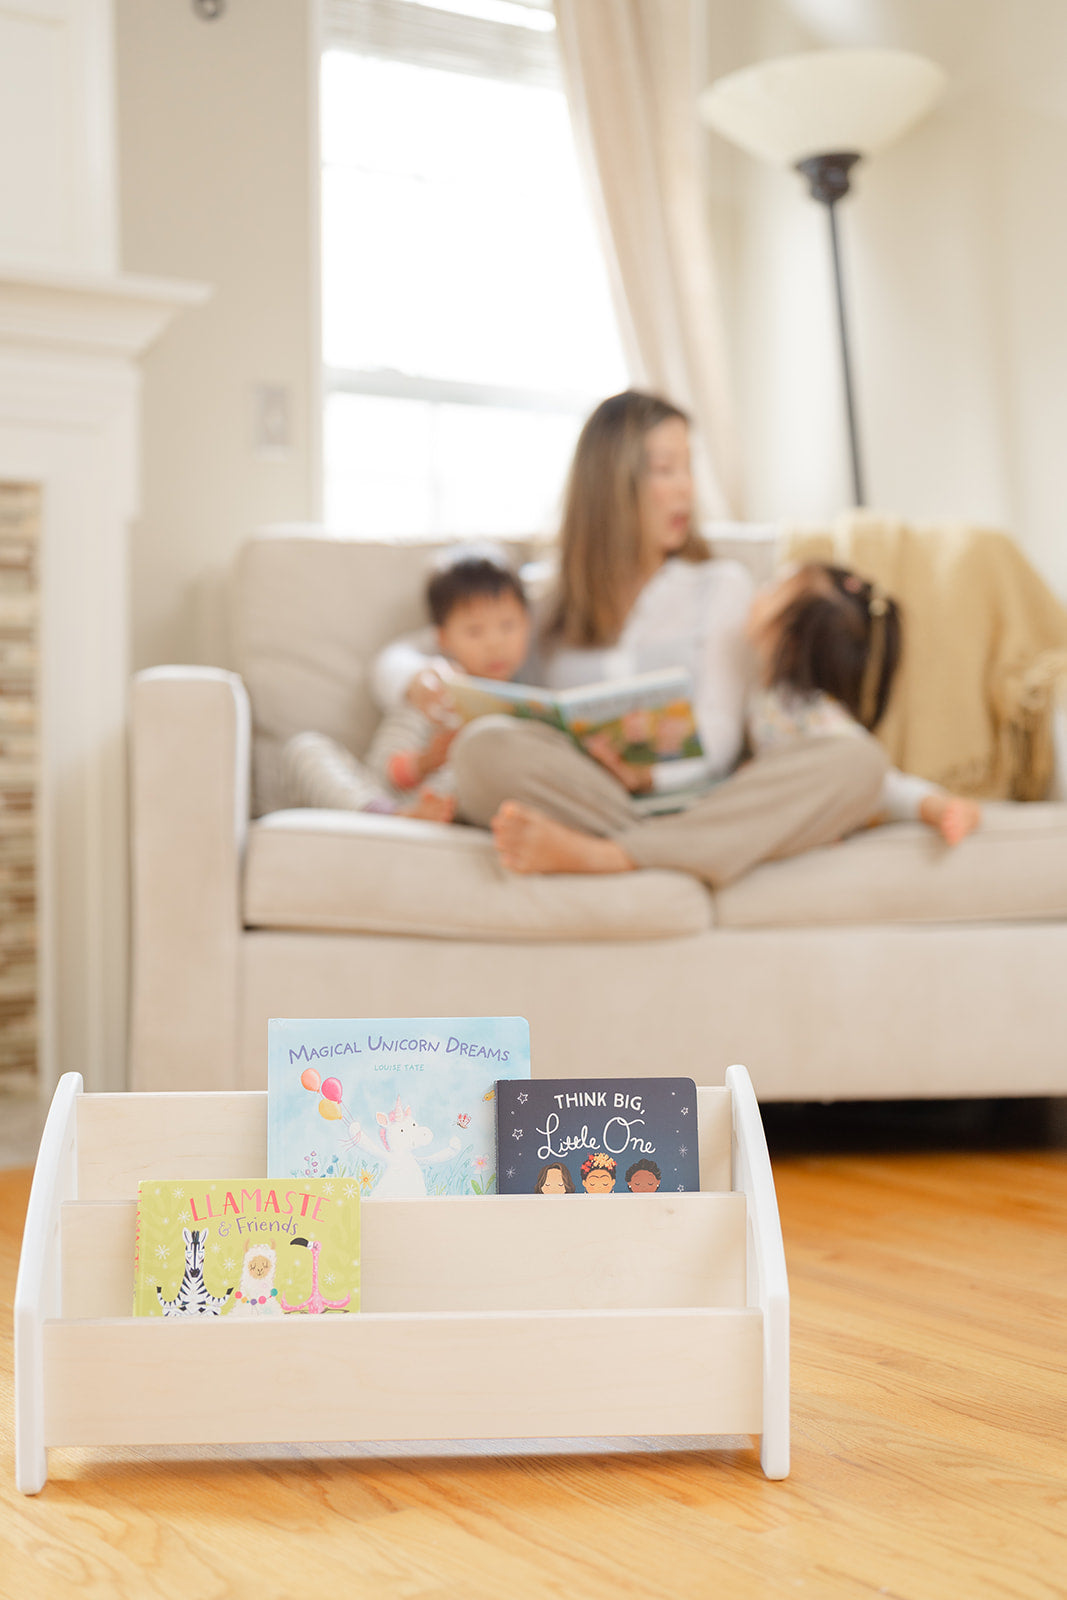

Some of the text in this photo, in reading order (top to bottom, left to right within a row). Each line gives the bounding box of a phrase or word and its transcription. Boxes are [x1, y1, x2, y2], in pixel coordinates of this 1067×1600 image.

[289, 1035, 510, 1065] MAGICAL UNICORN DREAMS
[374, 1064, 401, 1072] LOUISE
[554, 1092, 646, 1115] THINK BIG,
[535, 1113, 656, 1160] Little One
[189, 1188, 331, 1223] LLAMASTE
[218, 1216, 299, 1238] & Friends
